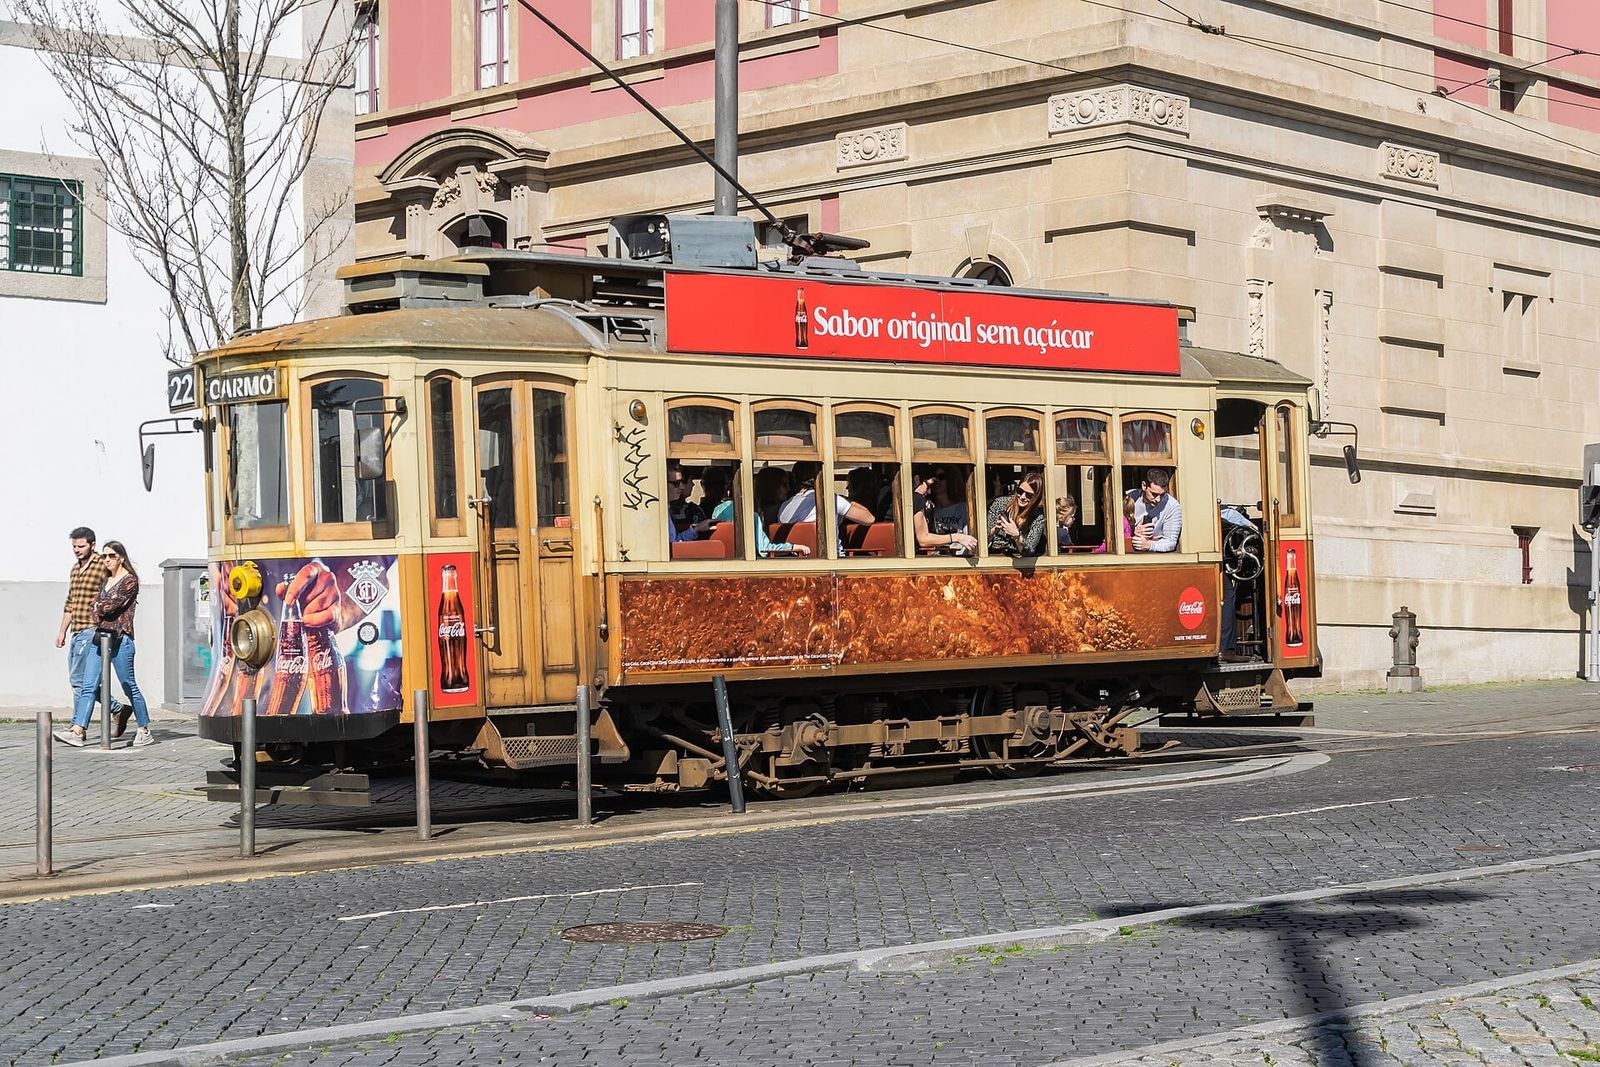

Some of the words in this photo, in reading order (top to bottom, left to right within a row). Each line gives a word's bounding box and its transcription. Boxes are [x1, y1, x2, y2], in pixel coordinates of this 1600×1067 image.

[813, 306, 883, 338] Sabor
[887, 312, 972, 348] original
[976, 322, 1020, 346] sem
[1023, 319, 1094, 354] açúcar
[169, 374, 193, 407] 22
[209, 374, 273, 400] CARMO
